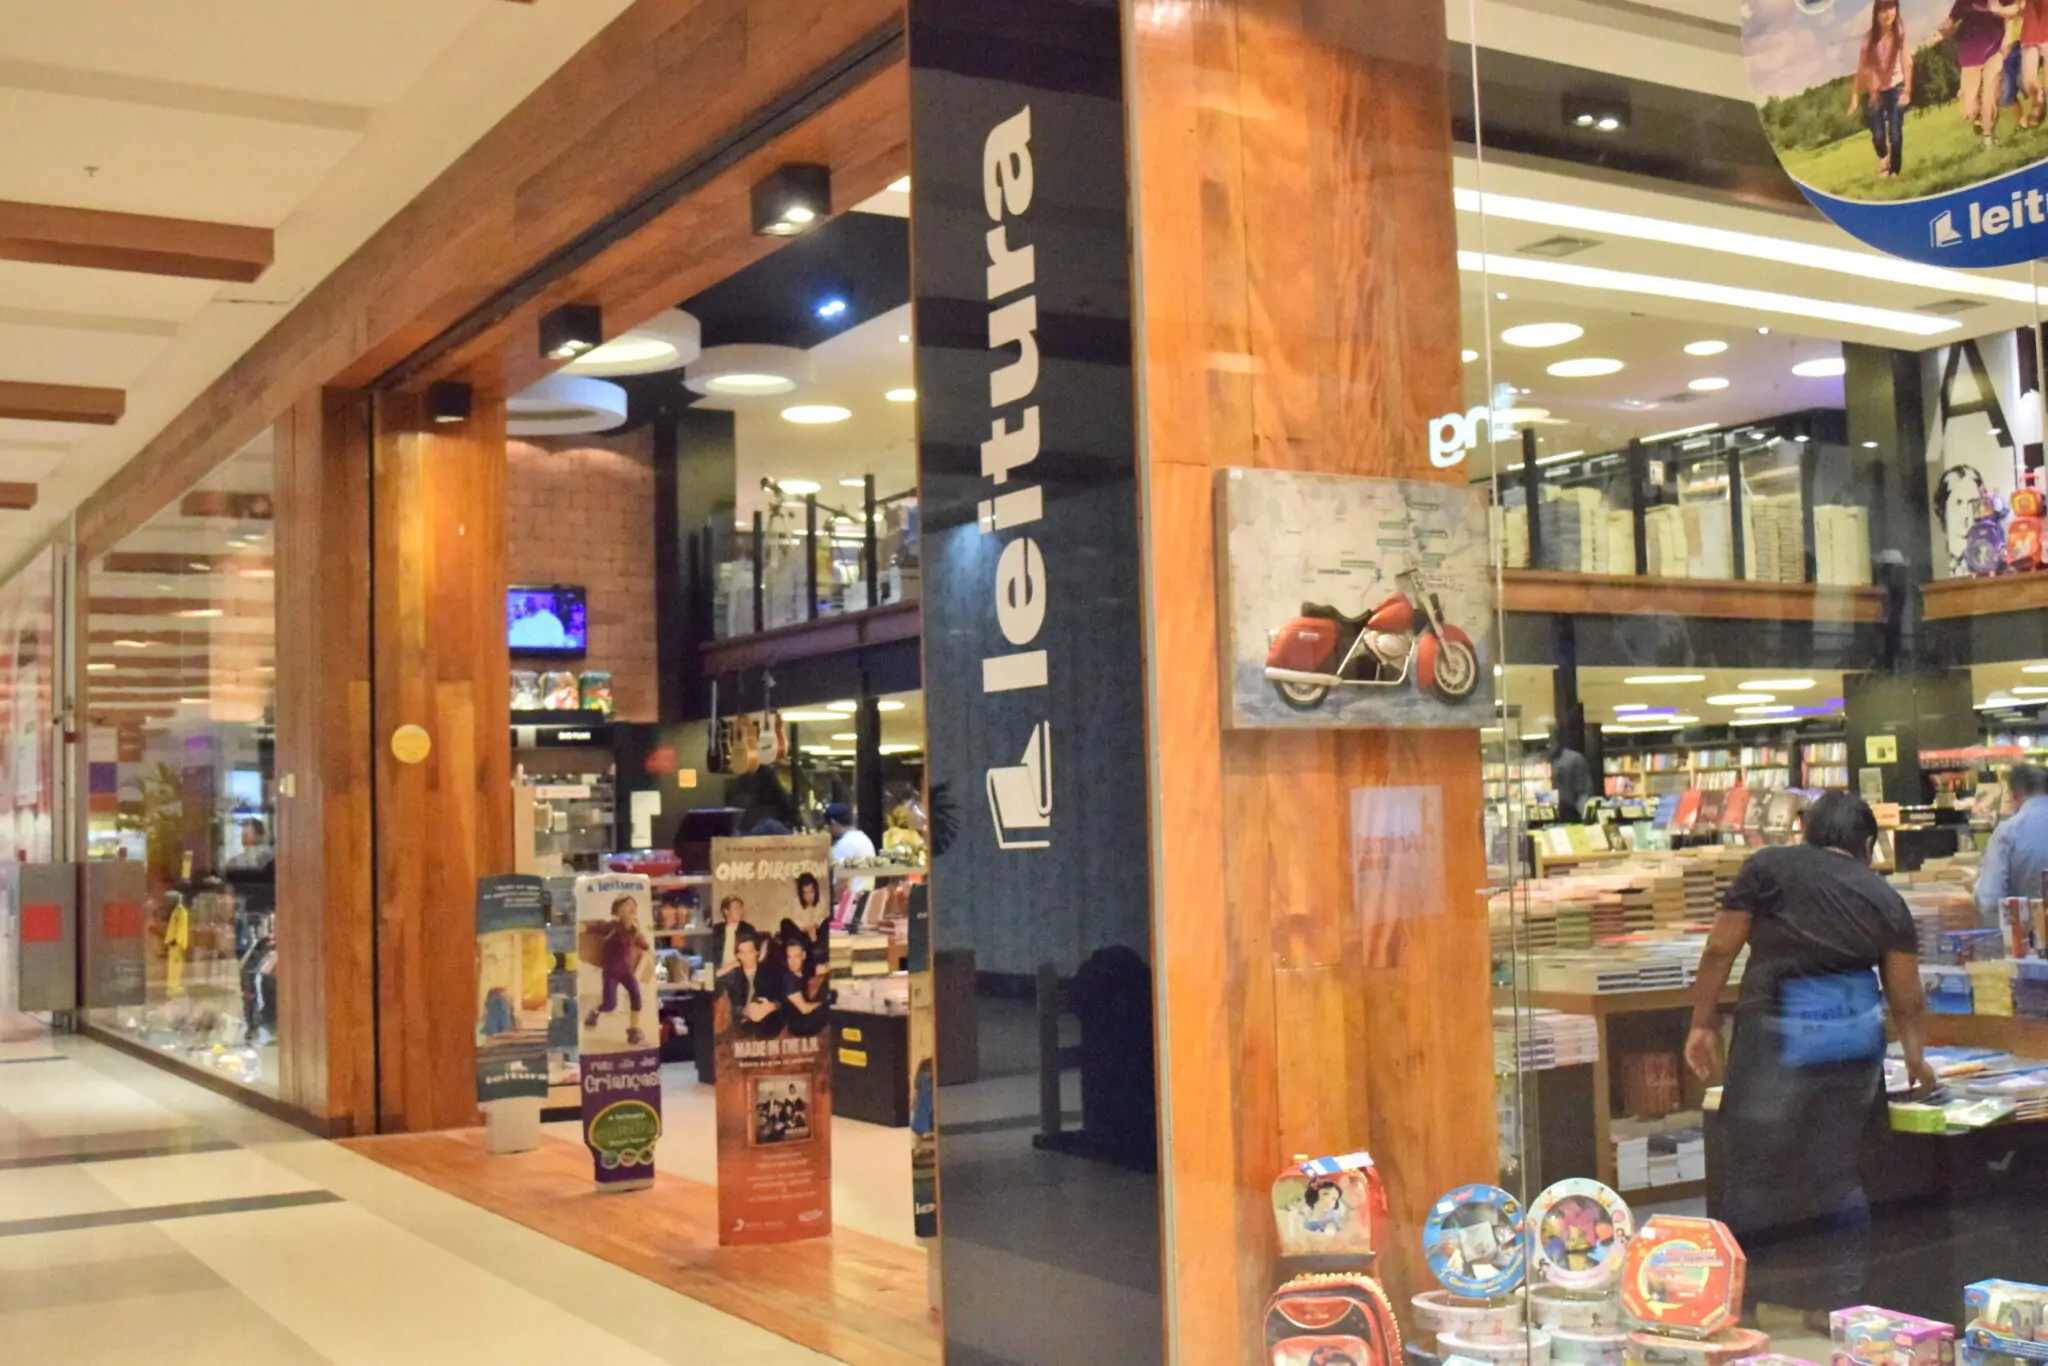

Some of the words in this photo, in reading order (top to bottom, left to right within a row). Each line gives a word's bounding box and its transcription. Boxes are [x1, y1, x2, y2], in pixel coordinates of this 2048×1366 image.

[1969, 189, 2048, 239] leit
[978, 104, 1048, 692] leitura
[715, 861, 757, 880] ONE
